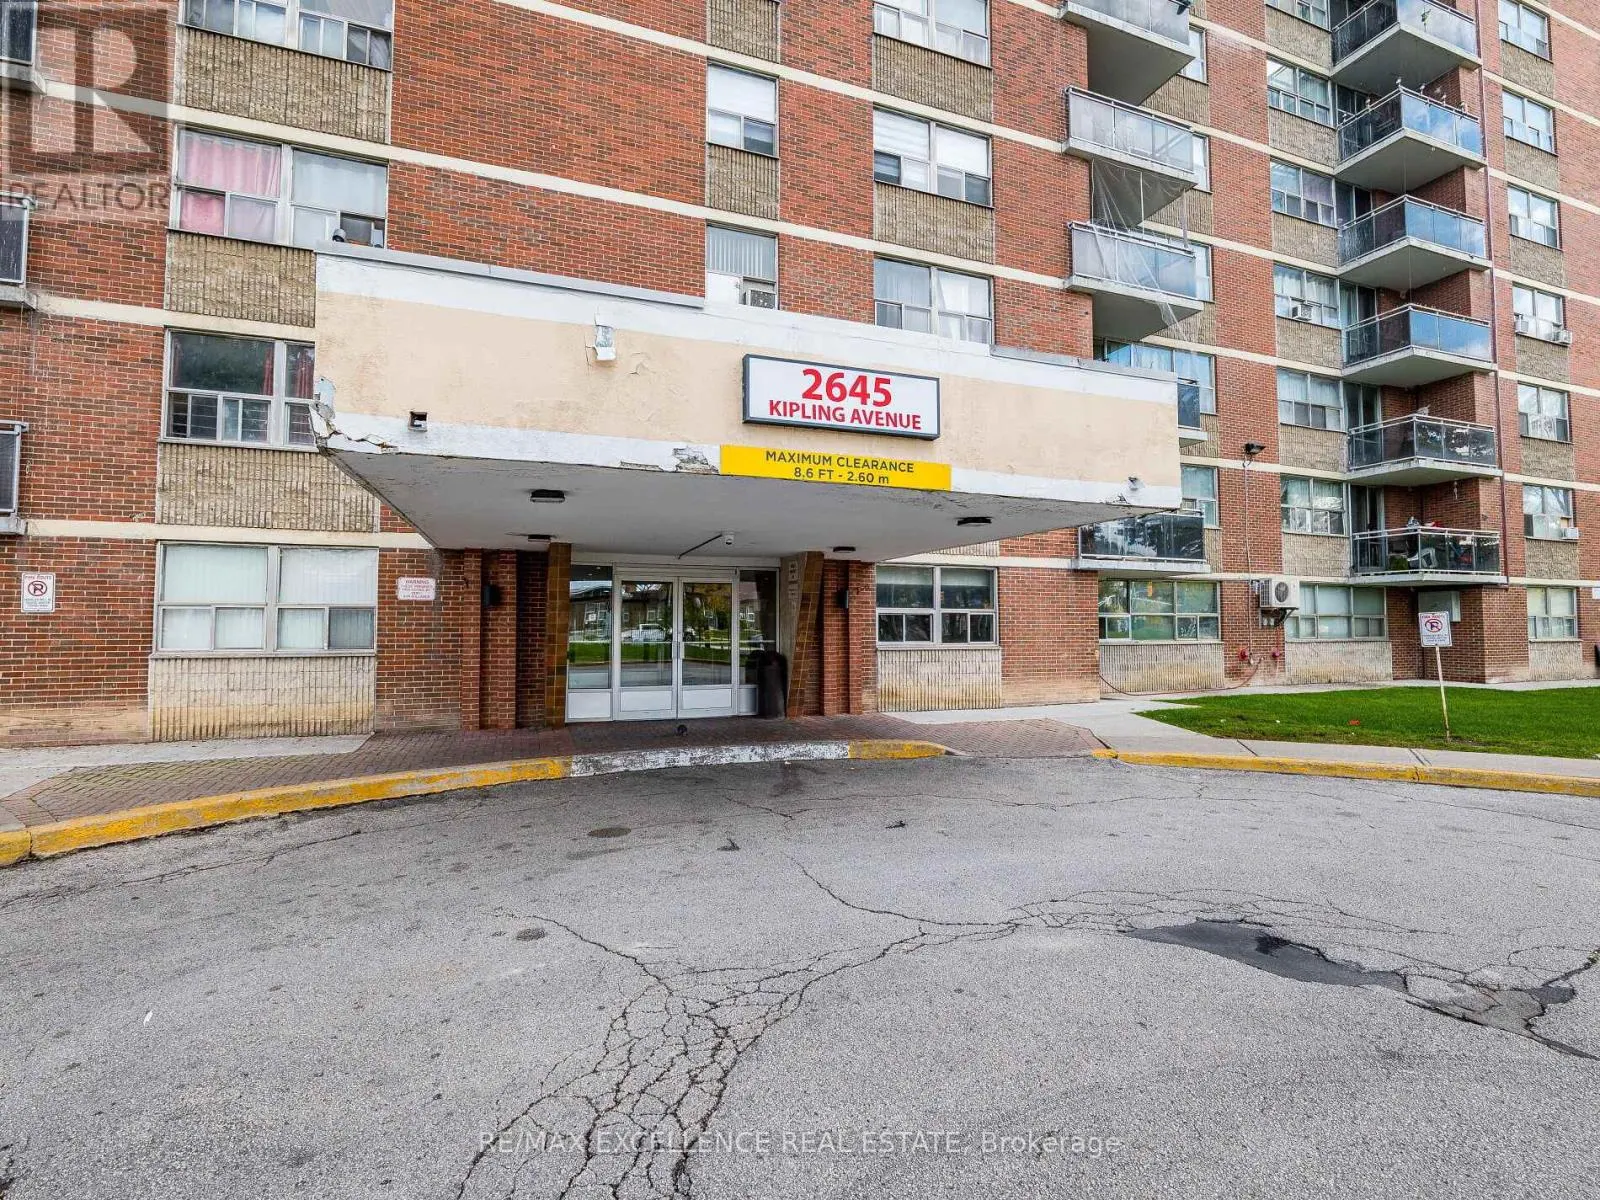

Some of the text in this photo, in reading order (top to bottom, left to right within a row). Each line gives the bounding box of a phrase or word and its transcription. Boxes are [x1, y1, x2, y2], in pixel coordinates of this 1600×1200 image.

[802, 368, 892, 408] 2645
[769, 399, 921, 430] KIPLING AVENUE
[766, 450, 914, 473] MAXIMUM CLEARANCE
[794, 467, 814, 479] 8.6
[818, 469, 834, 480] FT
[847, 471, 874, 483] 2.60
[878, 475, 889, 484] m
